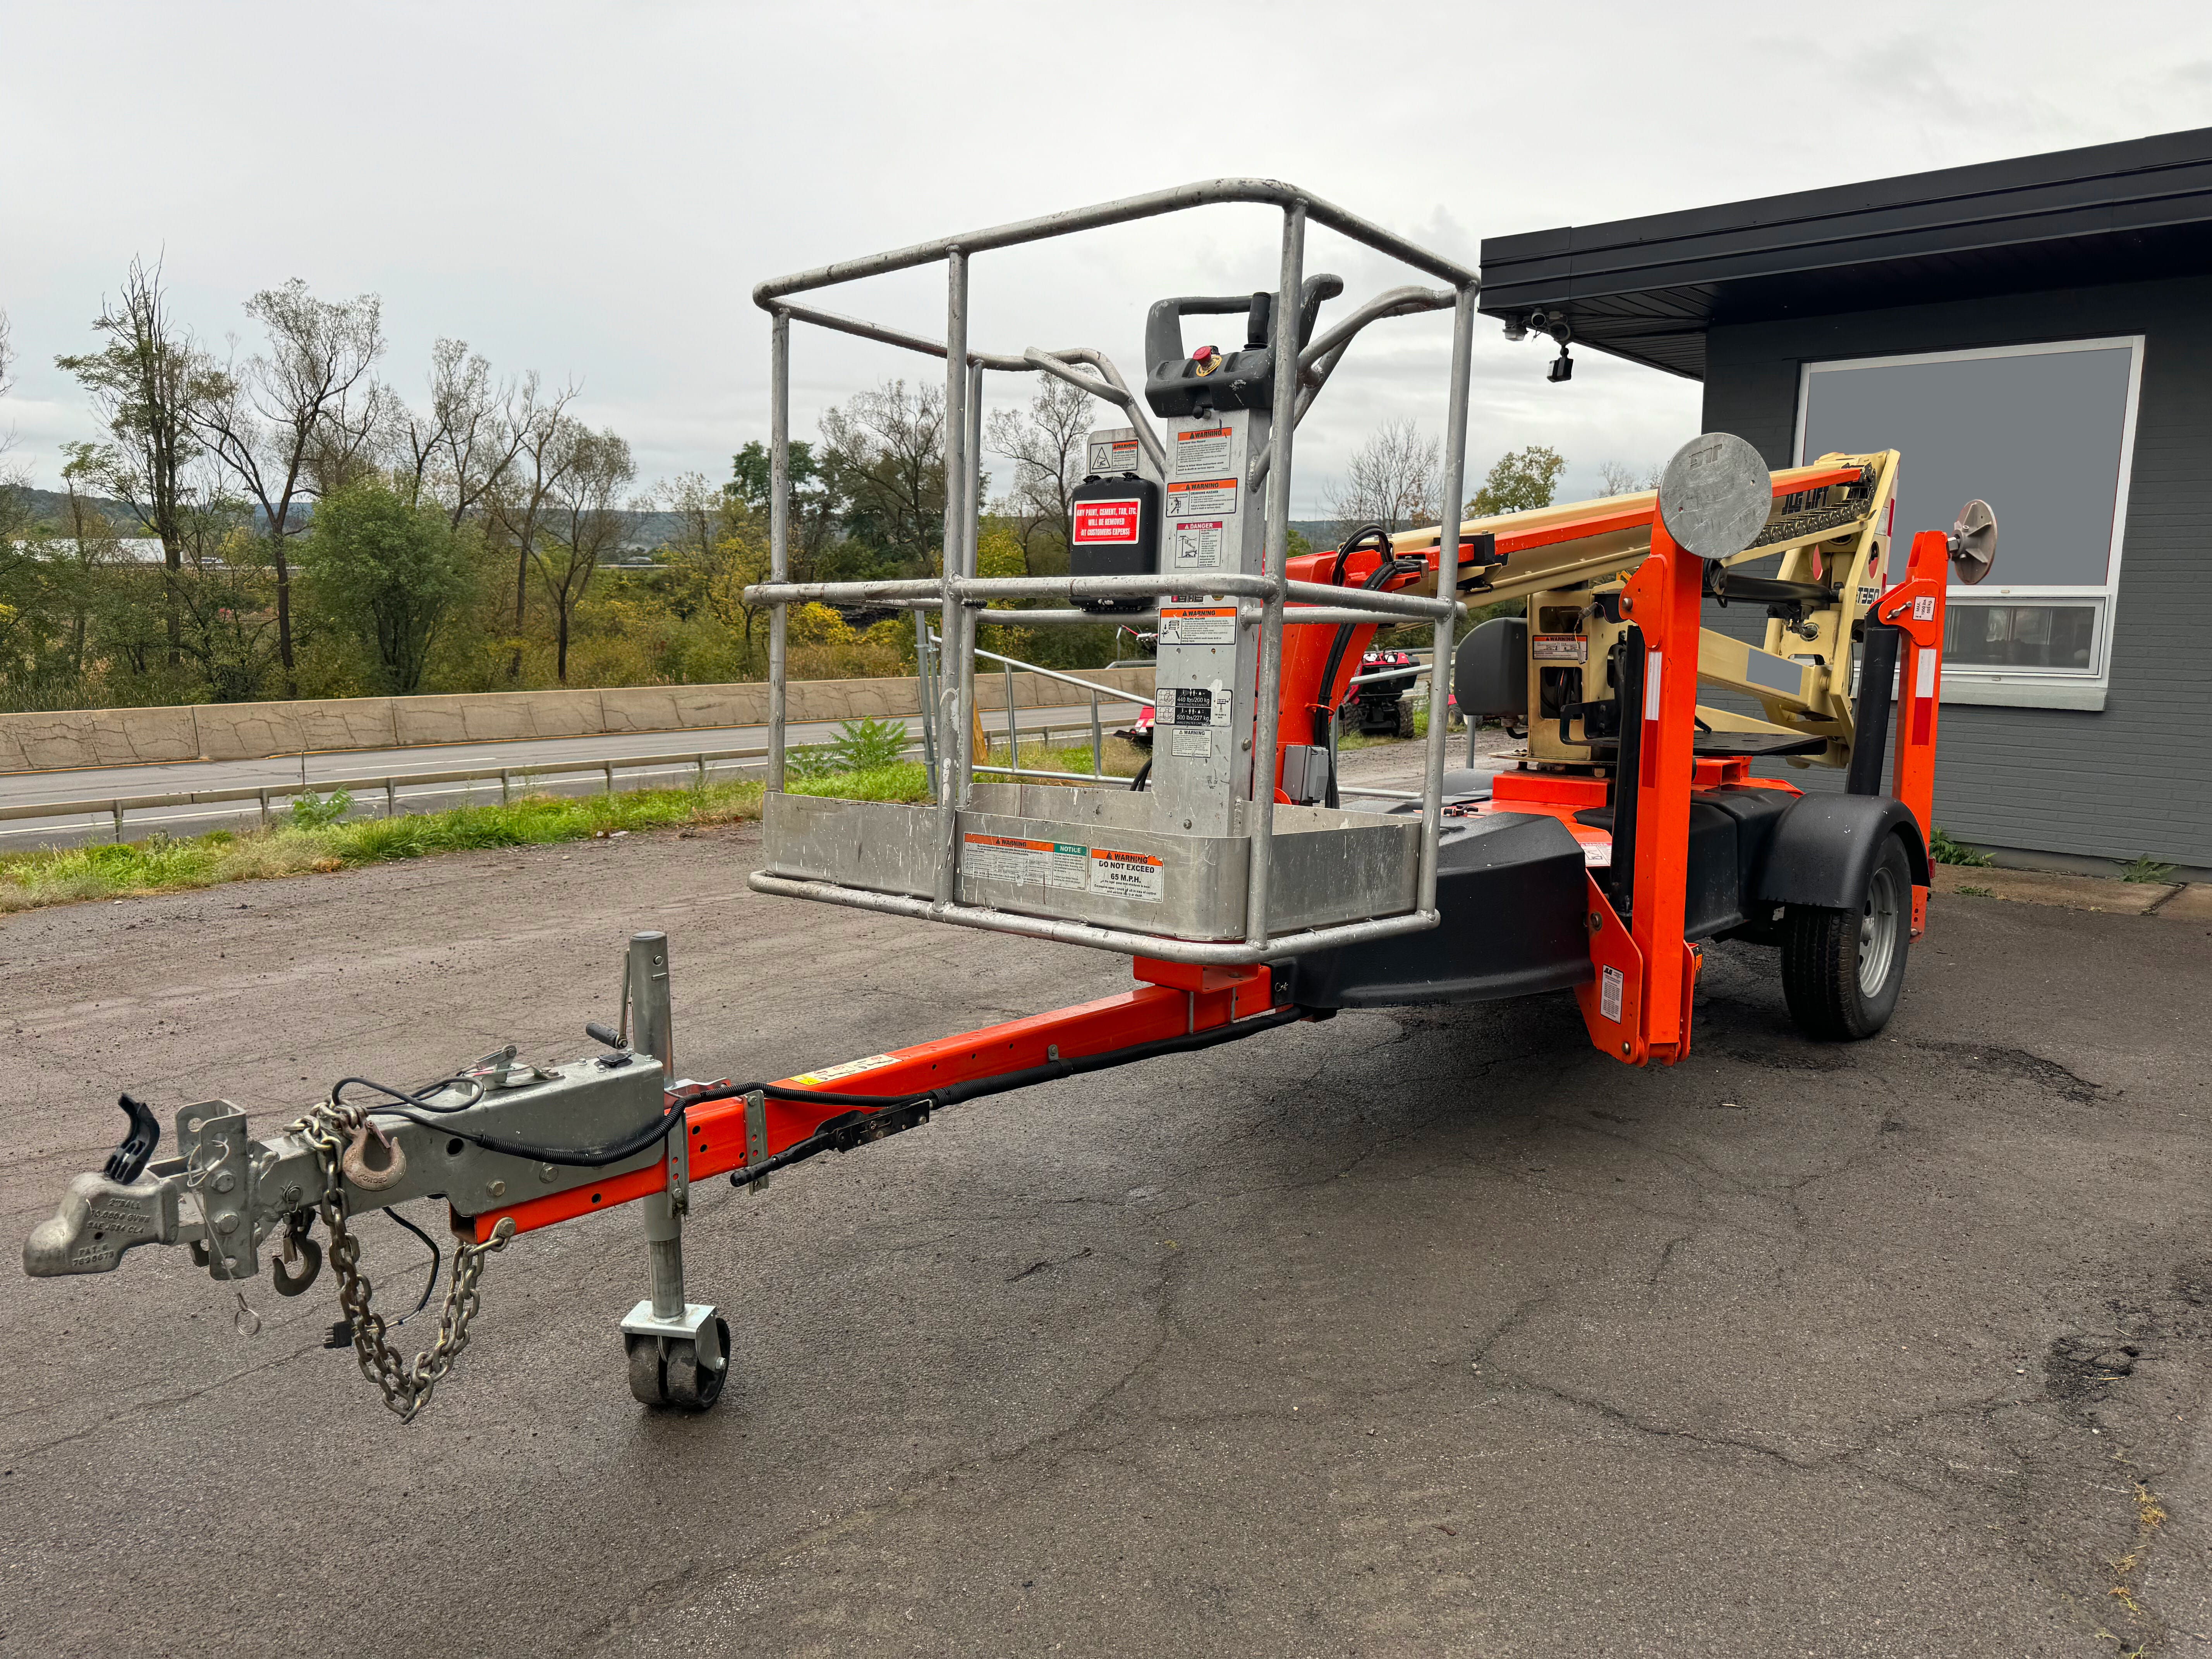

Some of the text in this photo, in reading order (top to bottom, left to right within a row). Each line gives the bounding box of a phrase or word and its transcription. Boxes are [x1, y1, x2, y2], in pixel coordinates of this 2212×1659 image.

[1195, 430, 1222, 438] WARNING
[1805, 486, 1829, 511] LIFT
[1858, 587, 1879, 604] T350
[1001, 839, 1026, 847] WARNING
[1060, 845, 1081, 854] NOTICE
[1115, 854, 1147, 864] WARNING
[1127, 864, 1154, 873] EXCEED
[1121, 874, 1141, 883] M.P.H.
[358, 1174, 387, 1183] FORGED
